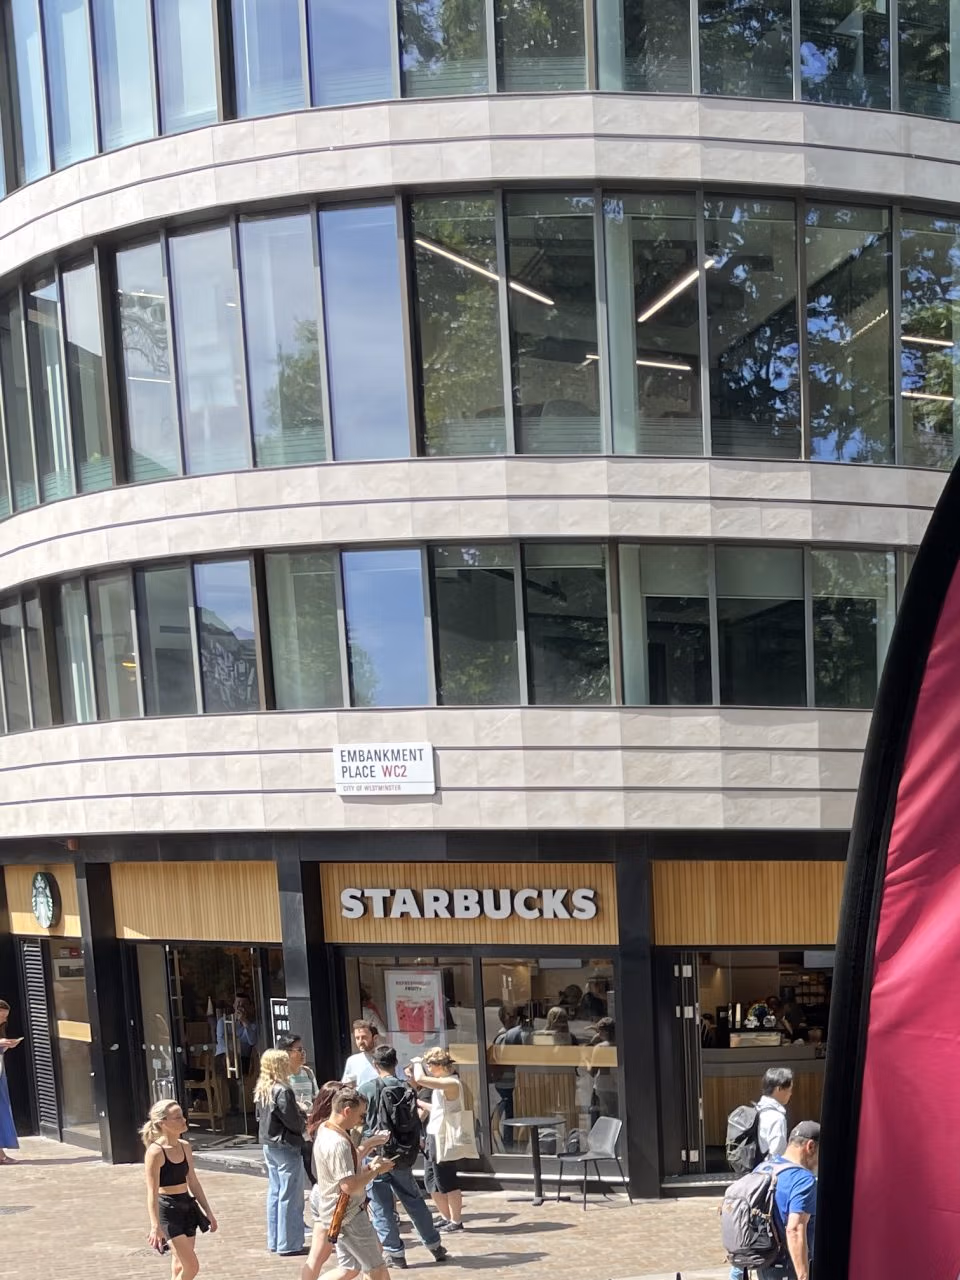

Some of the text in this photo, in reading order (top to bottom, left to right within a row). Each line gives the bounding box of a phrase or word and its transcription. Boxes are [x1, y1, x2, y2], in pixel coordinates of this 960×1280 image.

[340, 748, 424, 763] EMBANKMENT
[342, 765, 408, 778] PLACE WC2
[340, 887, 598, 920] STARBUCKS
